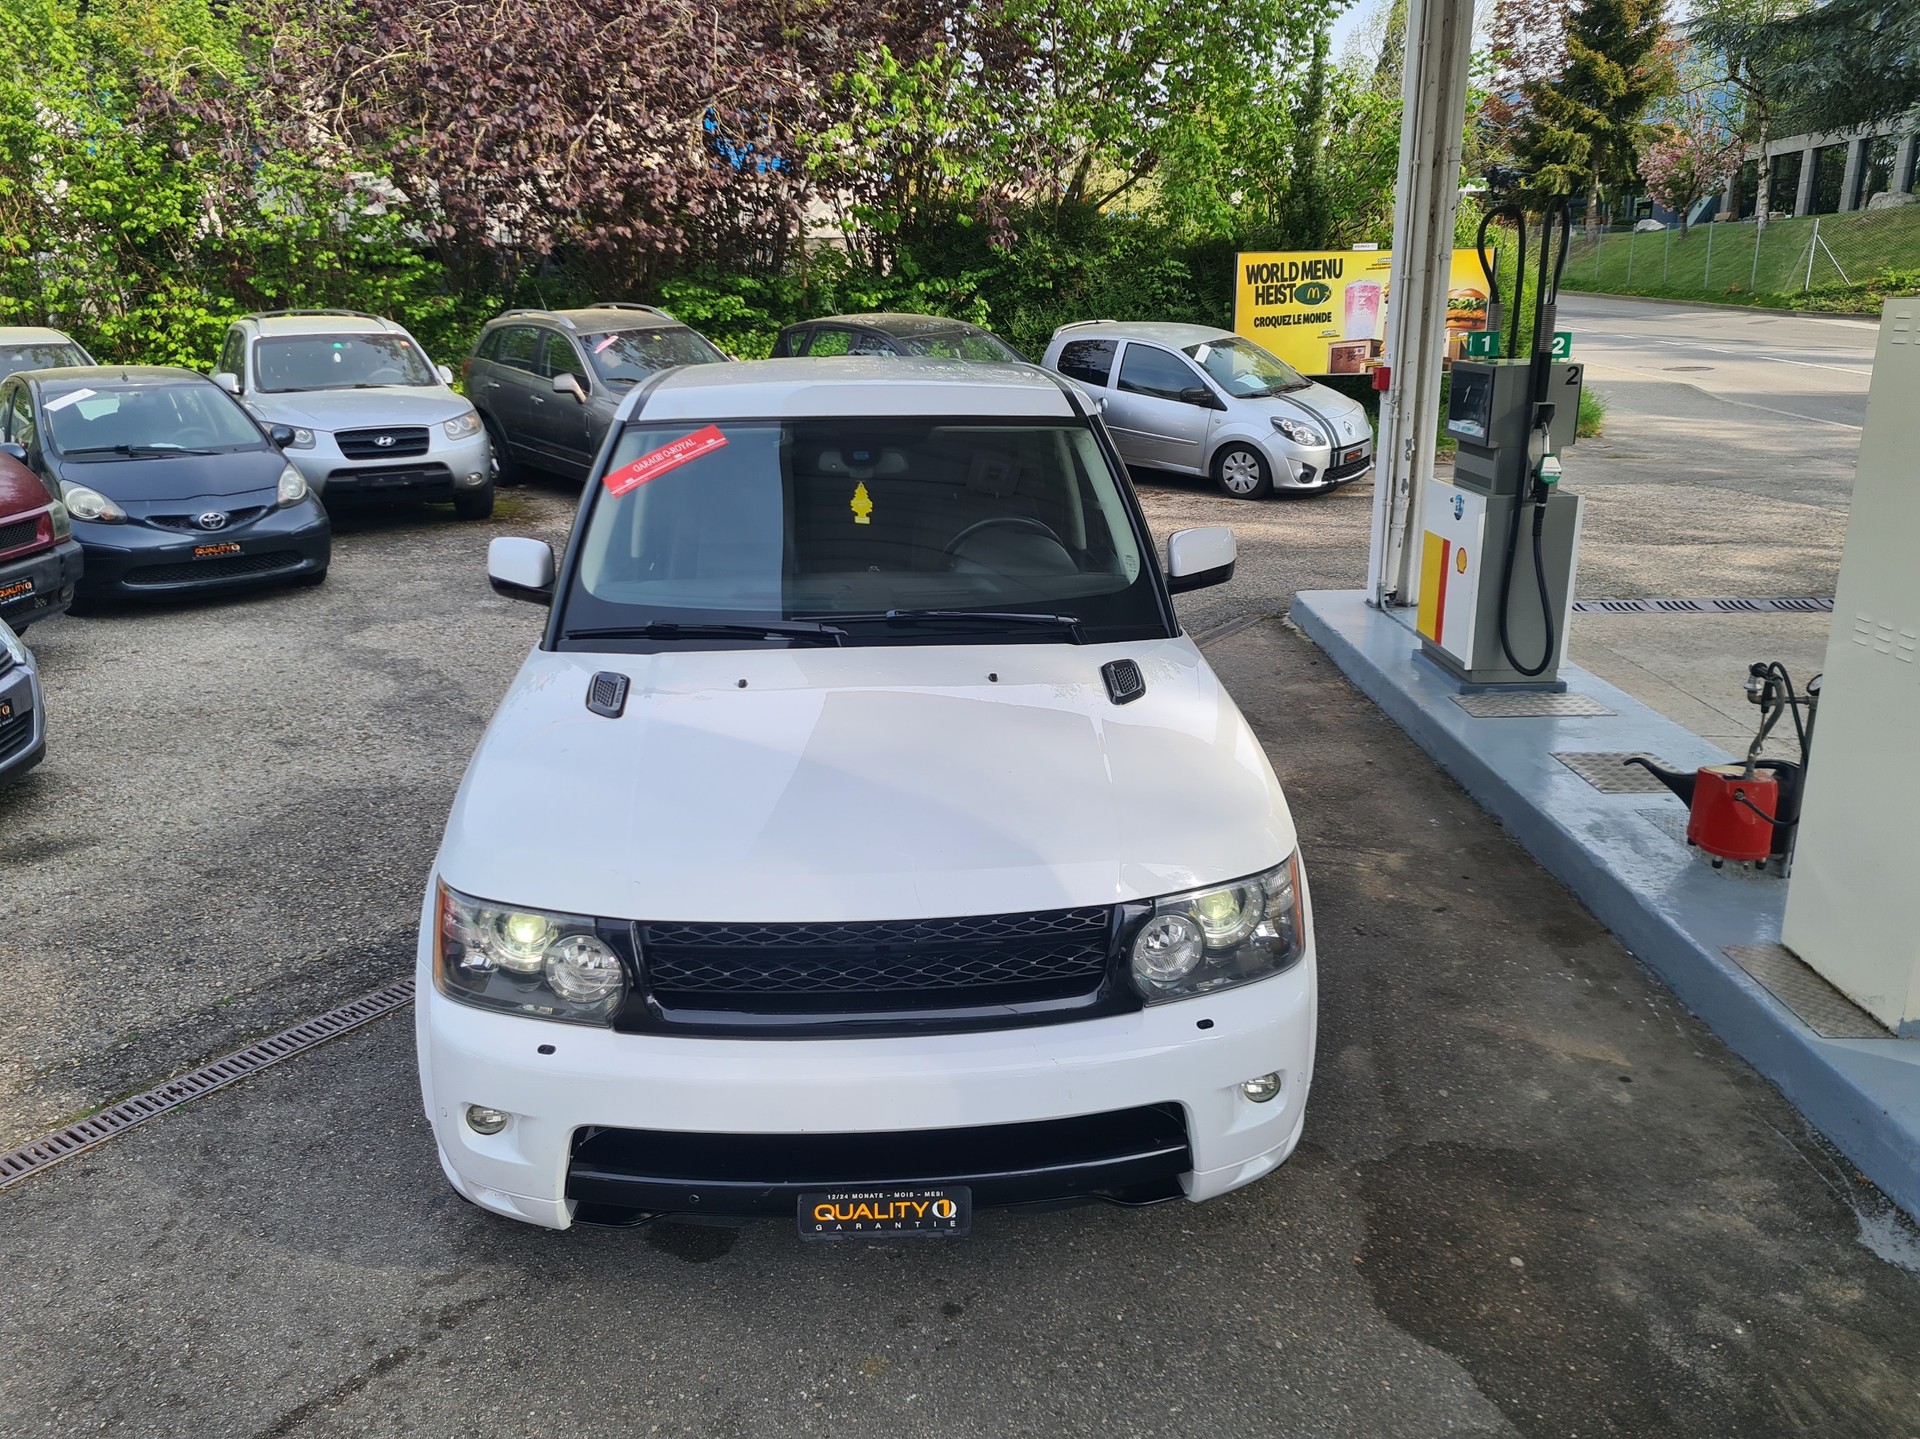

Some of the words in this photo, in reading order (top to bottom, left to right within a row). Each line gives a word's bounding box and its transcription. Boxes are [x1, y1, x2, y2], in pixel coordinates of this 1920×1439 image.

[1246, 262, 1300, 285] WORLD
[1301, 258, 1344, 281] MENU
[1255, 283, 1296, 306] HEIST
[1254, 314, 1292, 328] CROQUEZ
[1292, 314, 1302, 325] LE
[1303, 312, 1332, 324] MONDE
[1481, 335, 1491, 352] 1
[1552, 337, 1566, 354] 2
[1565, 366, 1580, 386] 2
[814, 1201, 930, 1221] QUALITY
[815, 1220, 956, 1231] GARANTIE
